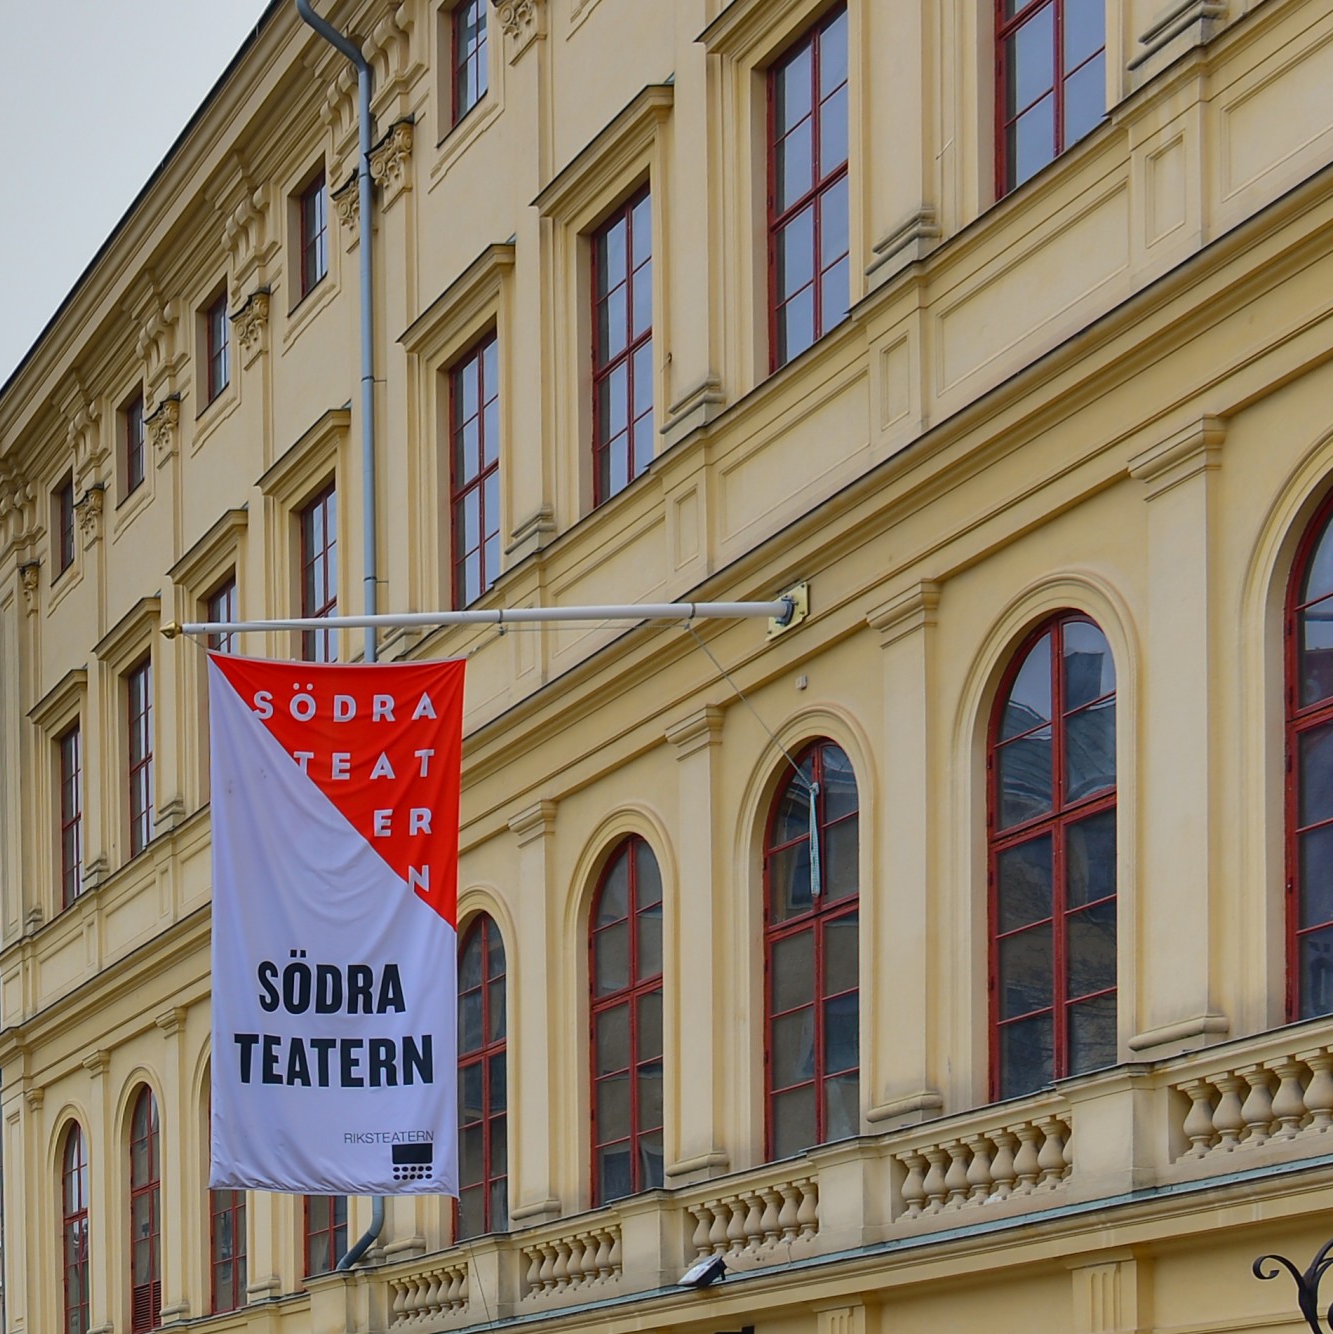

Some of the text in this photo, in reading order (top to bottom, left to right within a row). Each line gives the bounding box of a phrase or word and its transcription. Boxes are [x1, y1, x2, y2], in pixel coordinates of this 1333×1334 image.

[252, 682, 438, 723] SÖDRA
[294, 748, 436, 781] TEAT
[373, 807, 432, 838] ER
[408, 863, 430, 893] N
[257, 949, 407, 1015] SÖDRA
[234, 1033, 435, 1089] TEATERN
[343, 1130, 434, 1144] RIKSTEATERN
